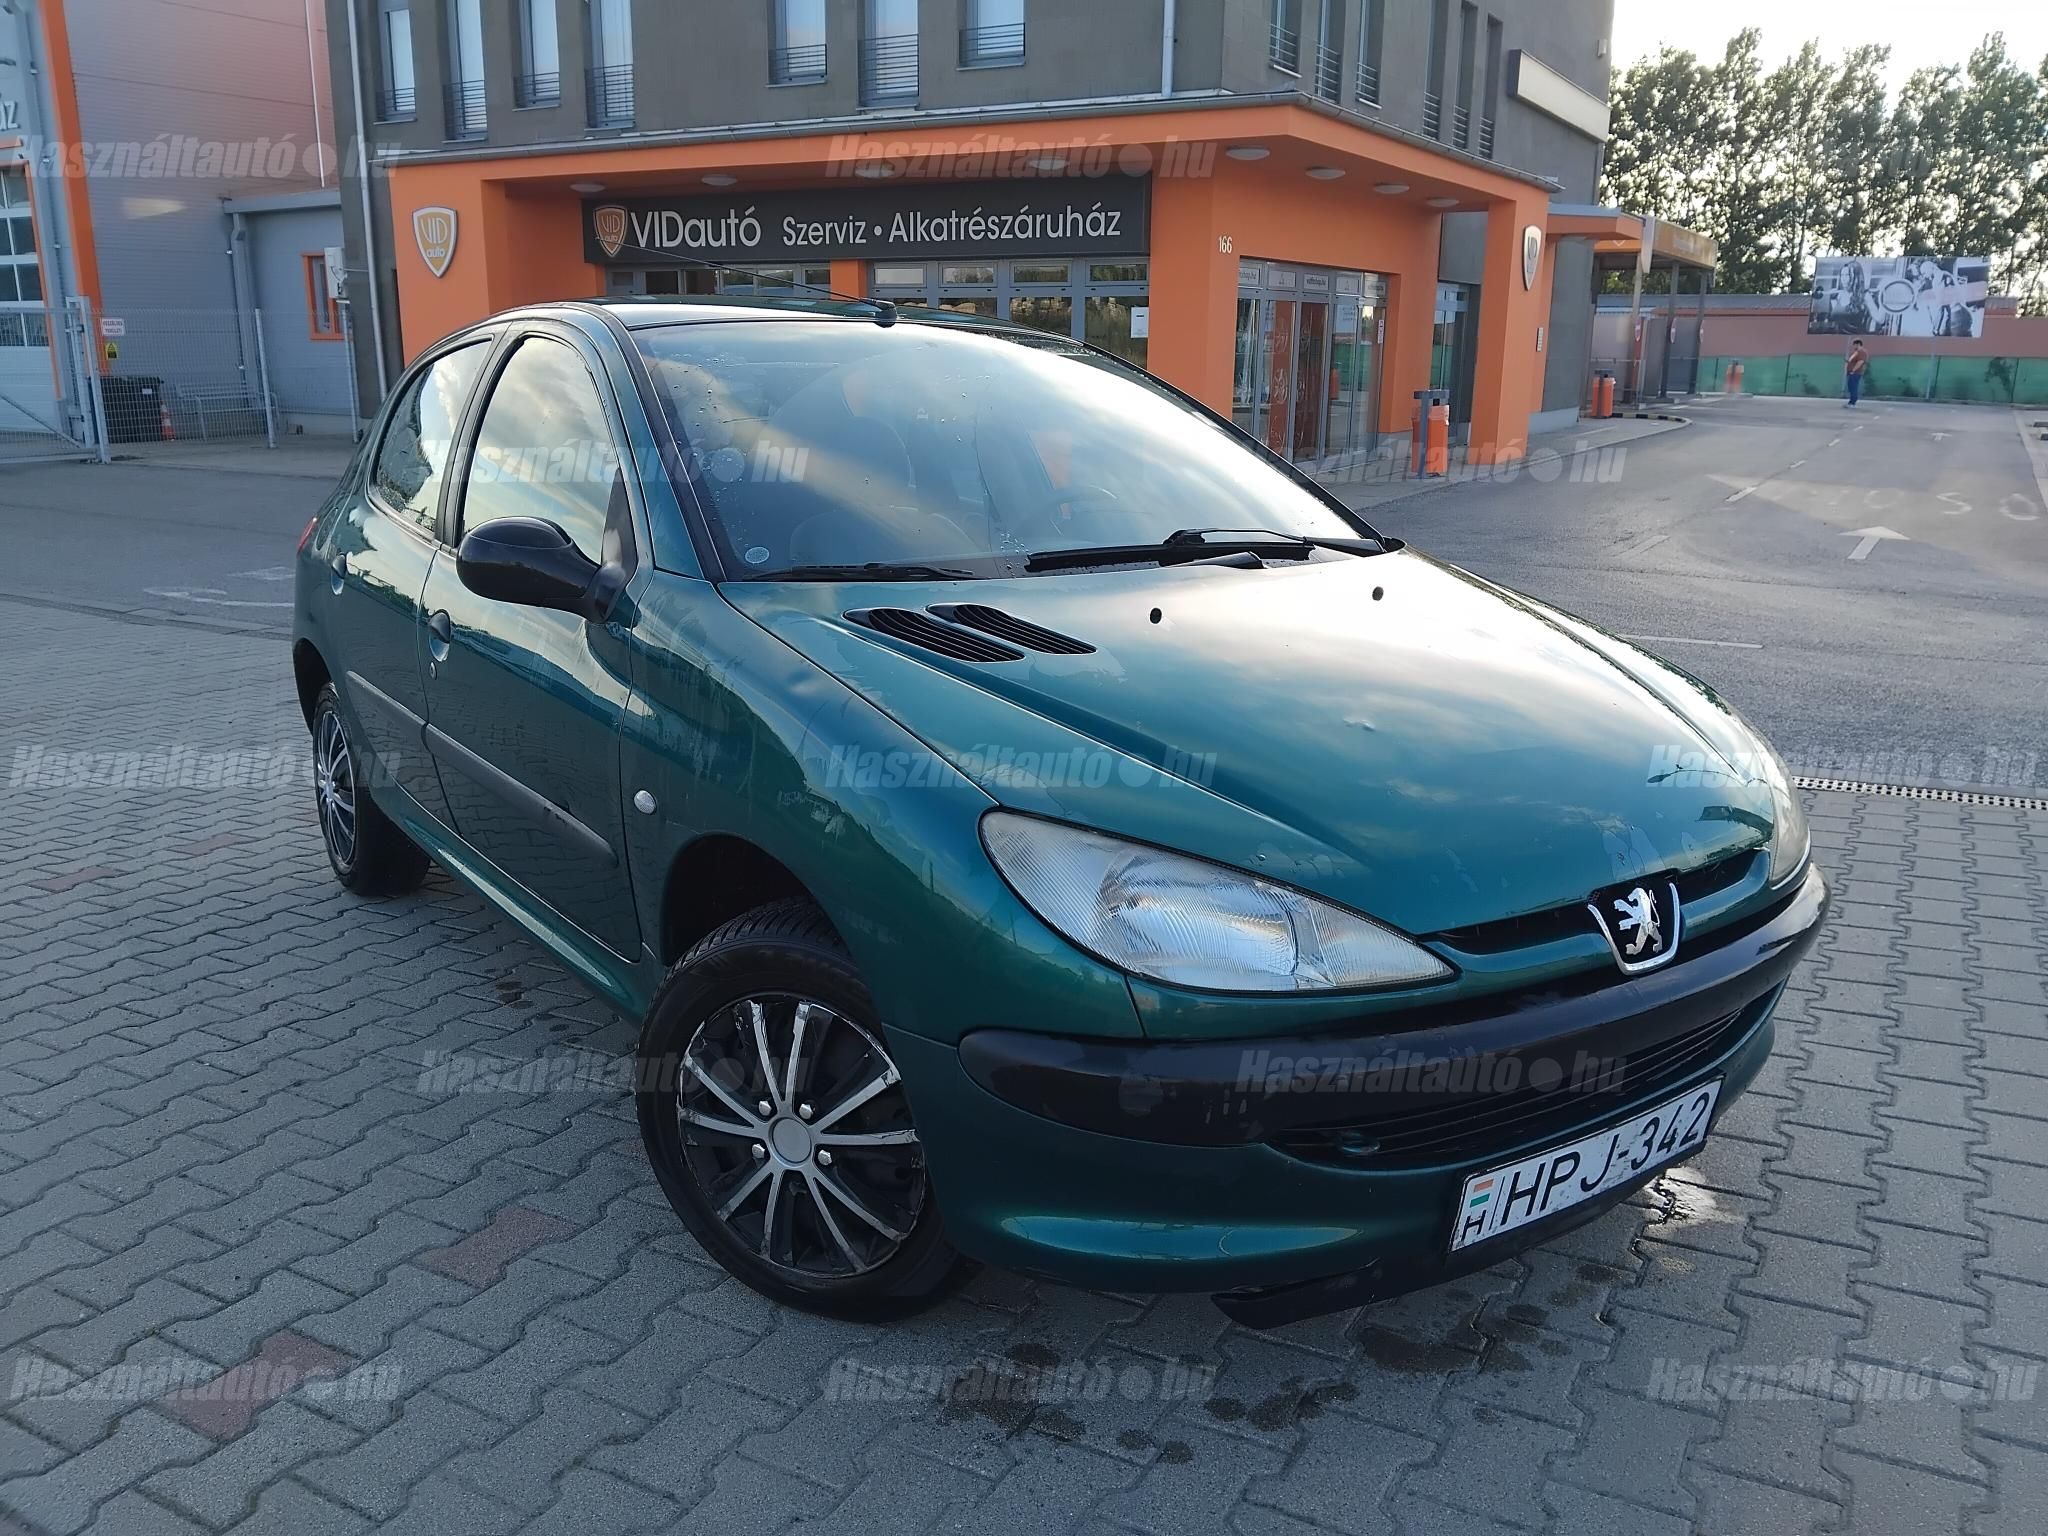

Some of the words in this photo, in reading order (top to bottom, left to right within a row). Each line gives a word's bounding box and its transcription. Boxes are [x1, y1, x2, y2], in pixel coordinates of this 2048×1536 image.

[420, 216, 448, 244] VID
[601, 215, 621, 233] VID
[630, 205, 762, 248] VIDautó
[783, 215, 867, 246] Szerviz
[888, 201, 1121, 243] Alkatrészáruház
[1219, 235, 1233, 254] 166
[1500, 1091, 1710, 1226] HPJ-342
